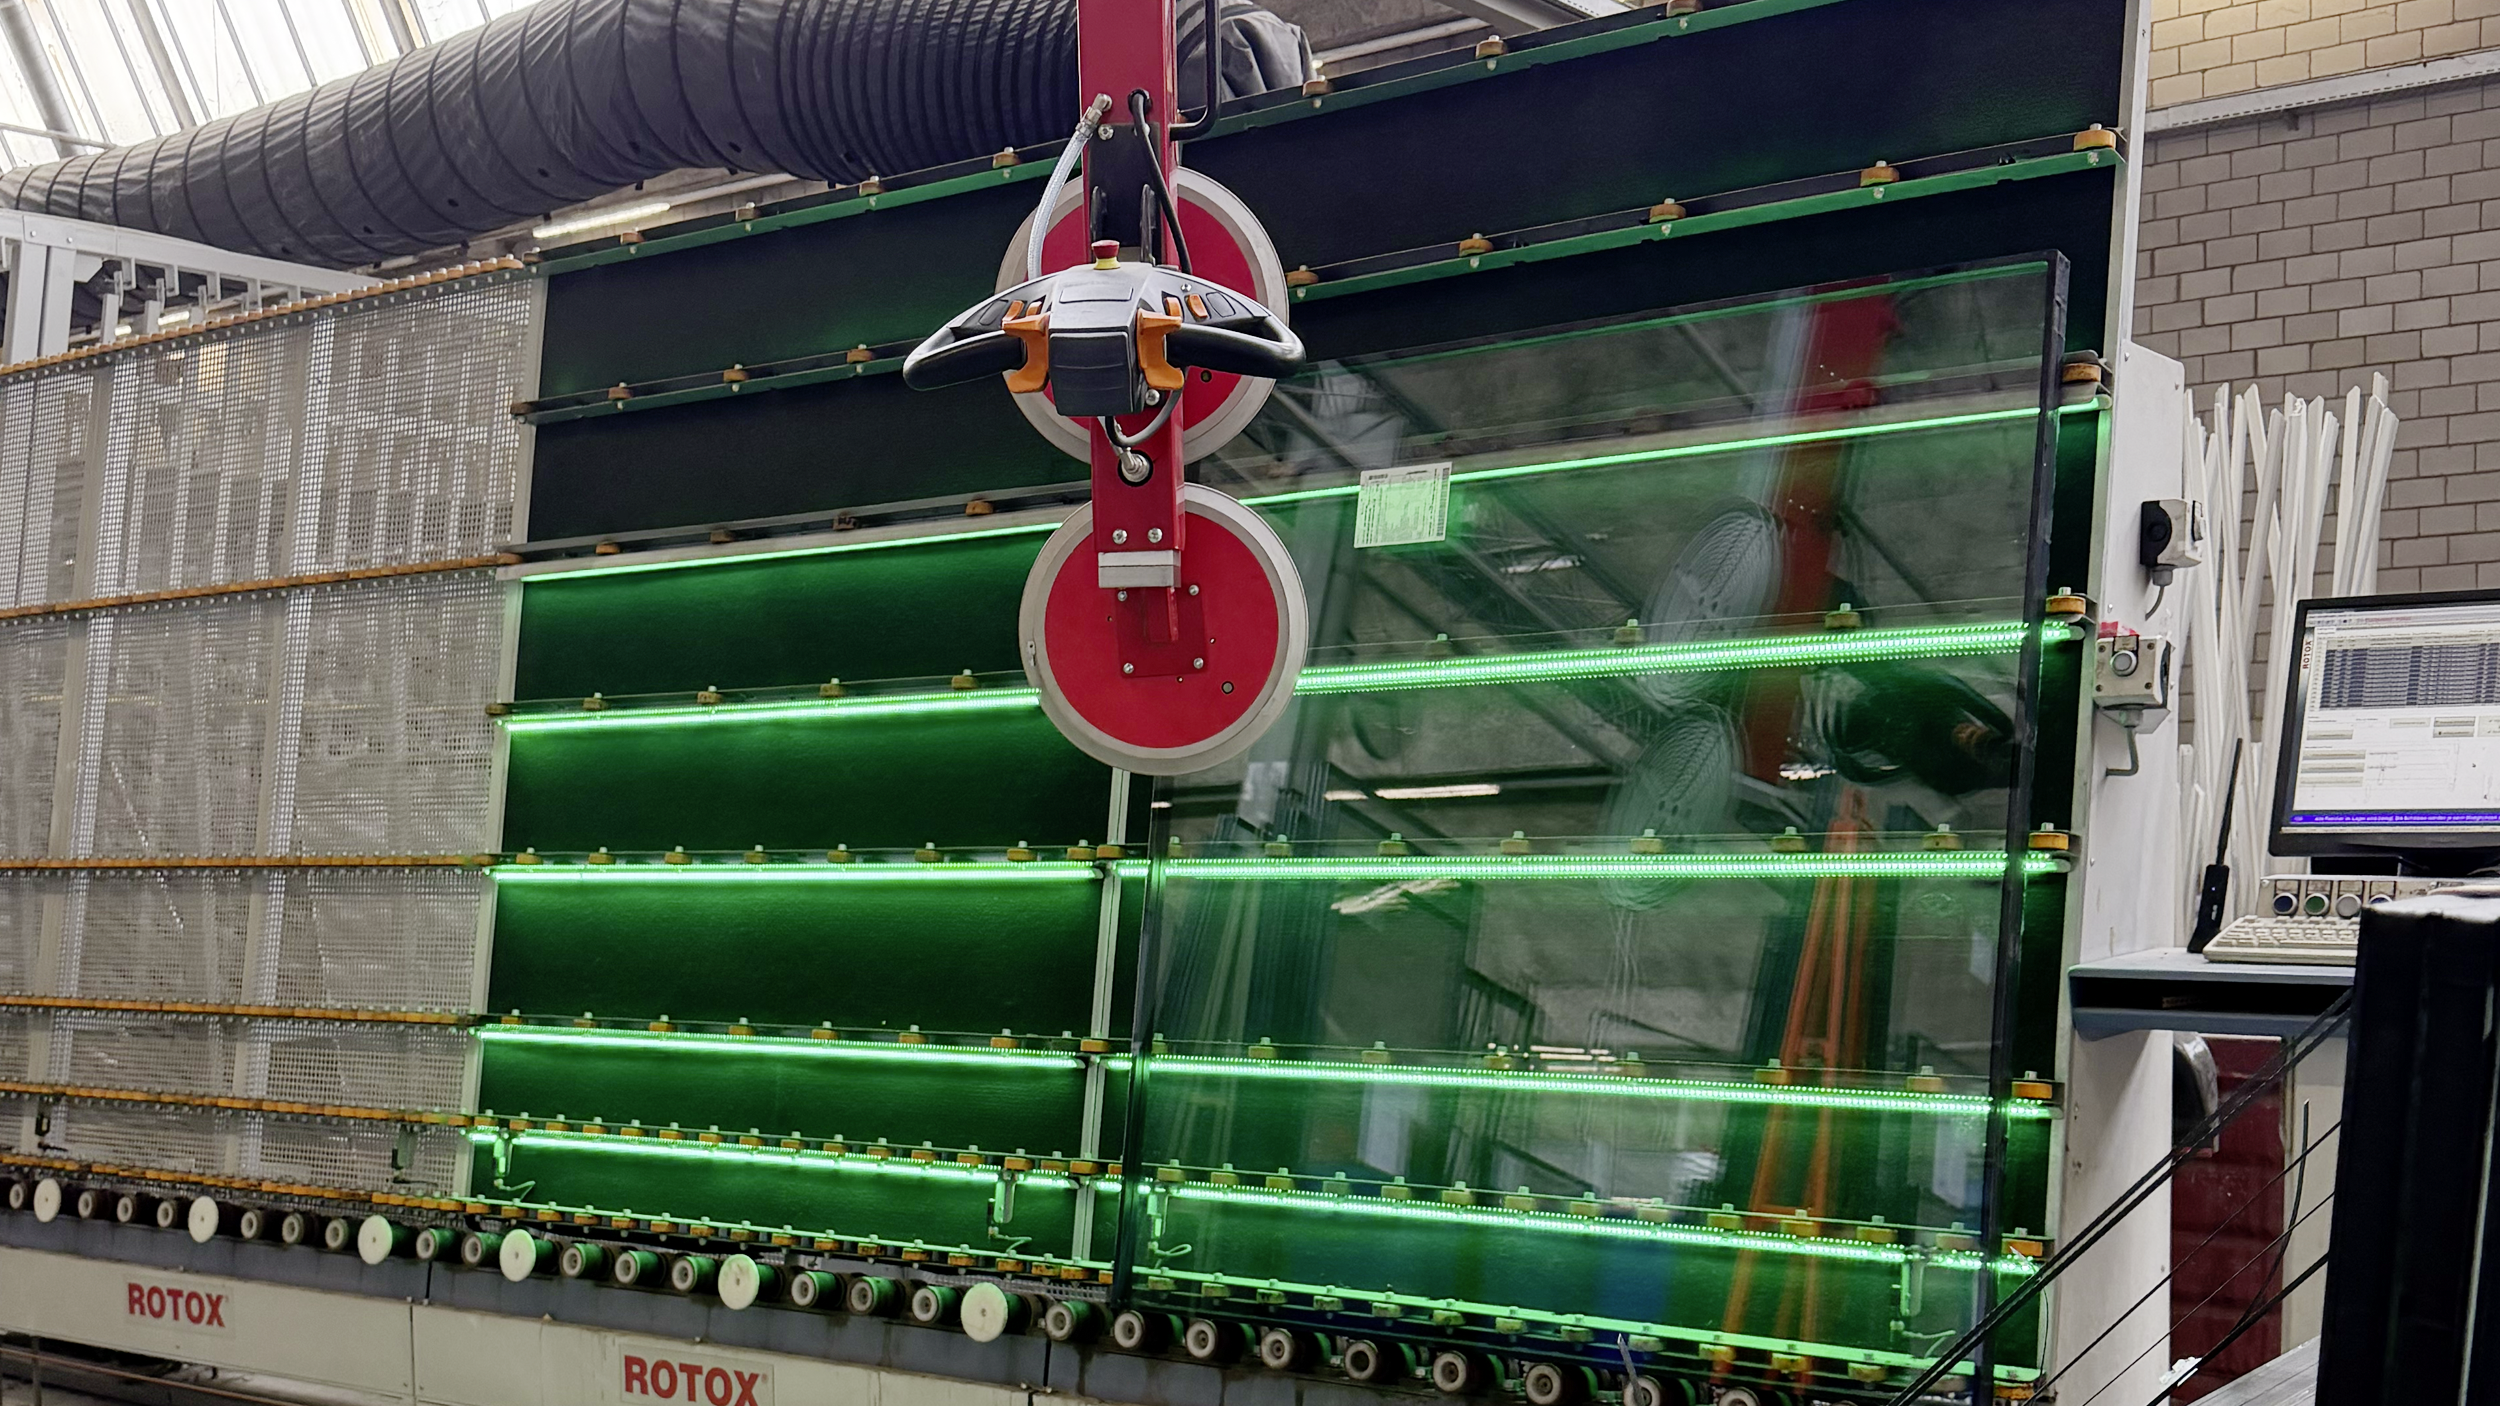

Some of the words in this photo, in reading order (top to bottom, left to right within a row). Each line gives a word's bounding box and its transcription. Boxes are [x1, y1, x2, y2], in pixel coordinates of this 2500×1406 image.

[2302, 641, 2312, 669] ROTOX
[128, 1283, 226, 1328] ROTOX
[624, 1354, 760, 1406] ROTOX
